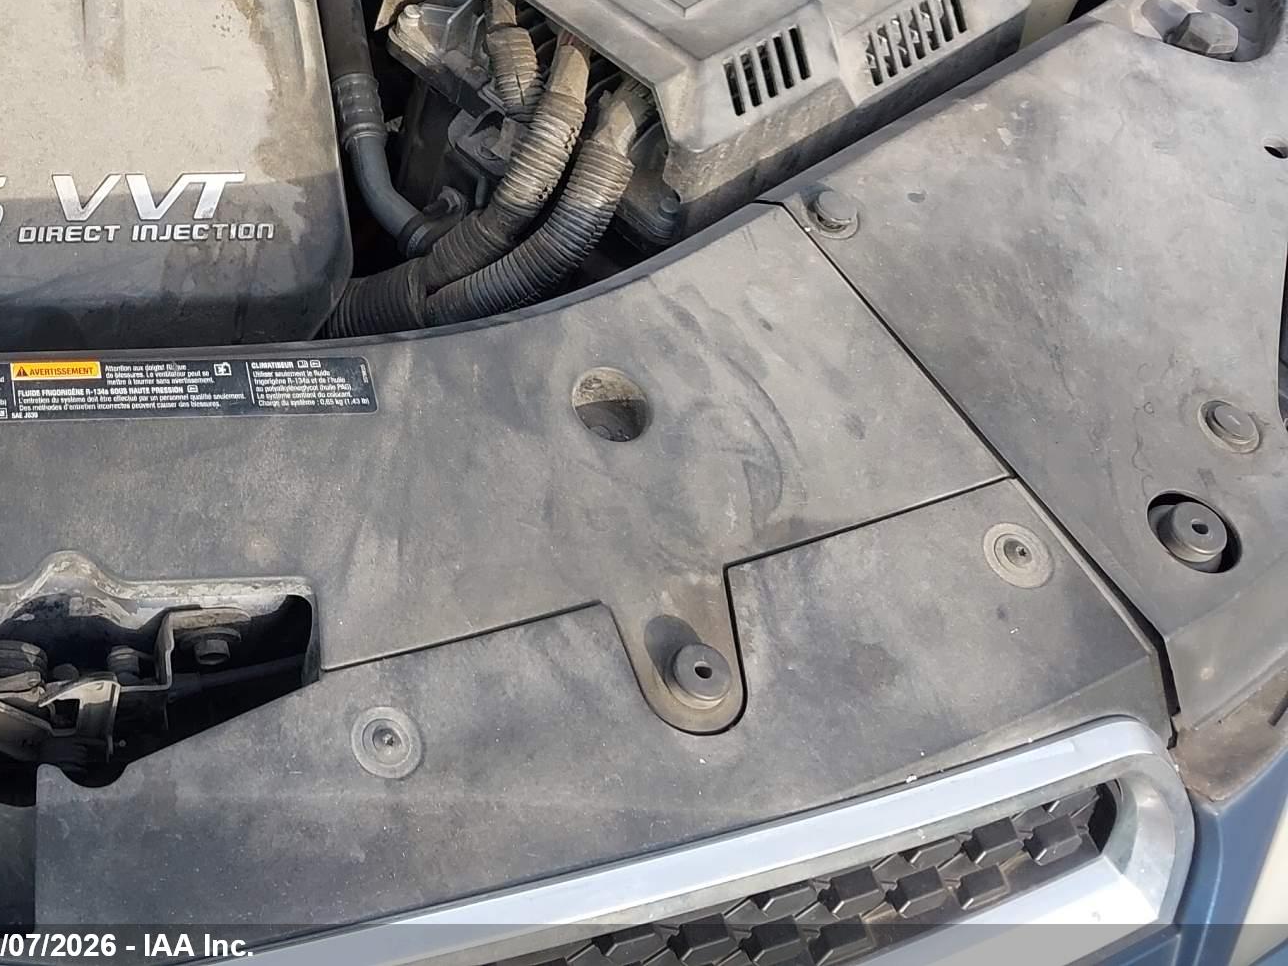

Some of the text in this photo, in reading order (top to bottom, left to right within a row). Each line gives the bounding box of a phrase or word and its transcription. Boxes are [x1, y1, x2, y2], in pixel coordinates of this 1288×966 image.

[51, 172, 246, 222] VVT
[17, 223, 120, 244] DIRECT
[30, 367, 93, 376] AVERTISSEMENT
